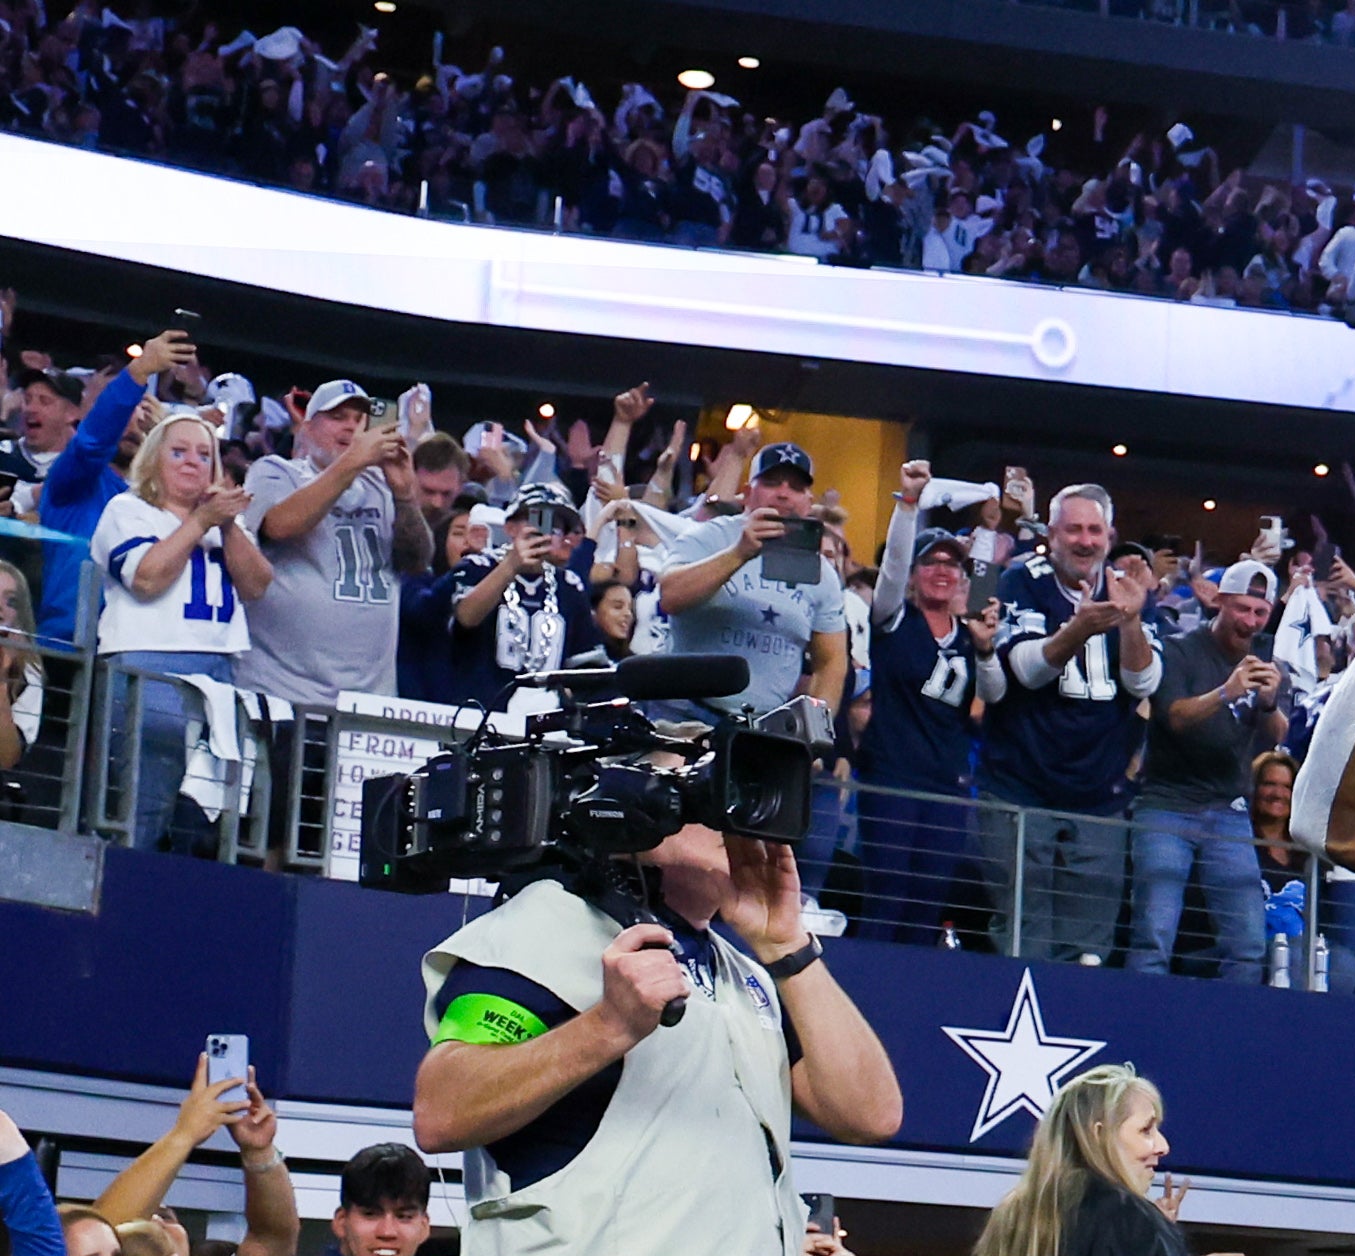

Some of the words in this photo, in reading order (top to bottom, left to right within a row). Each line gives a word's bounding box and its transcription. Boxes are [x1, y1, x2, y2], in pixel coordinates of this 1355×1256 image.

[333, 524, 393, 605] 11
[350, 732, 416, 760] FROM
[482, 1009, 527, 1040] WEEK
